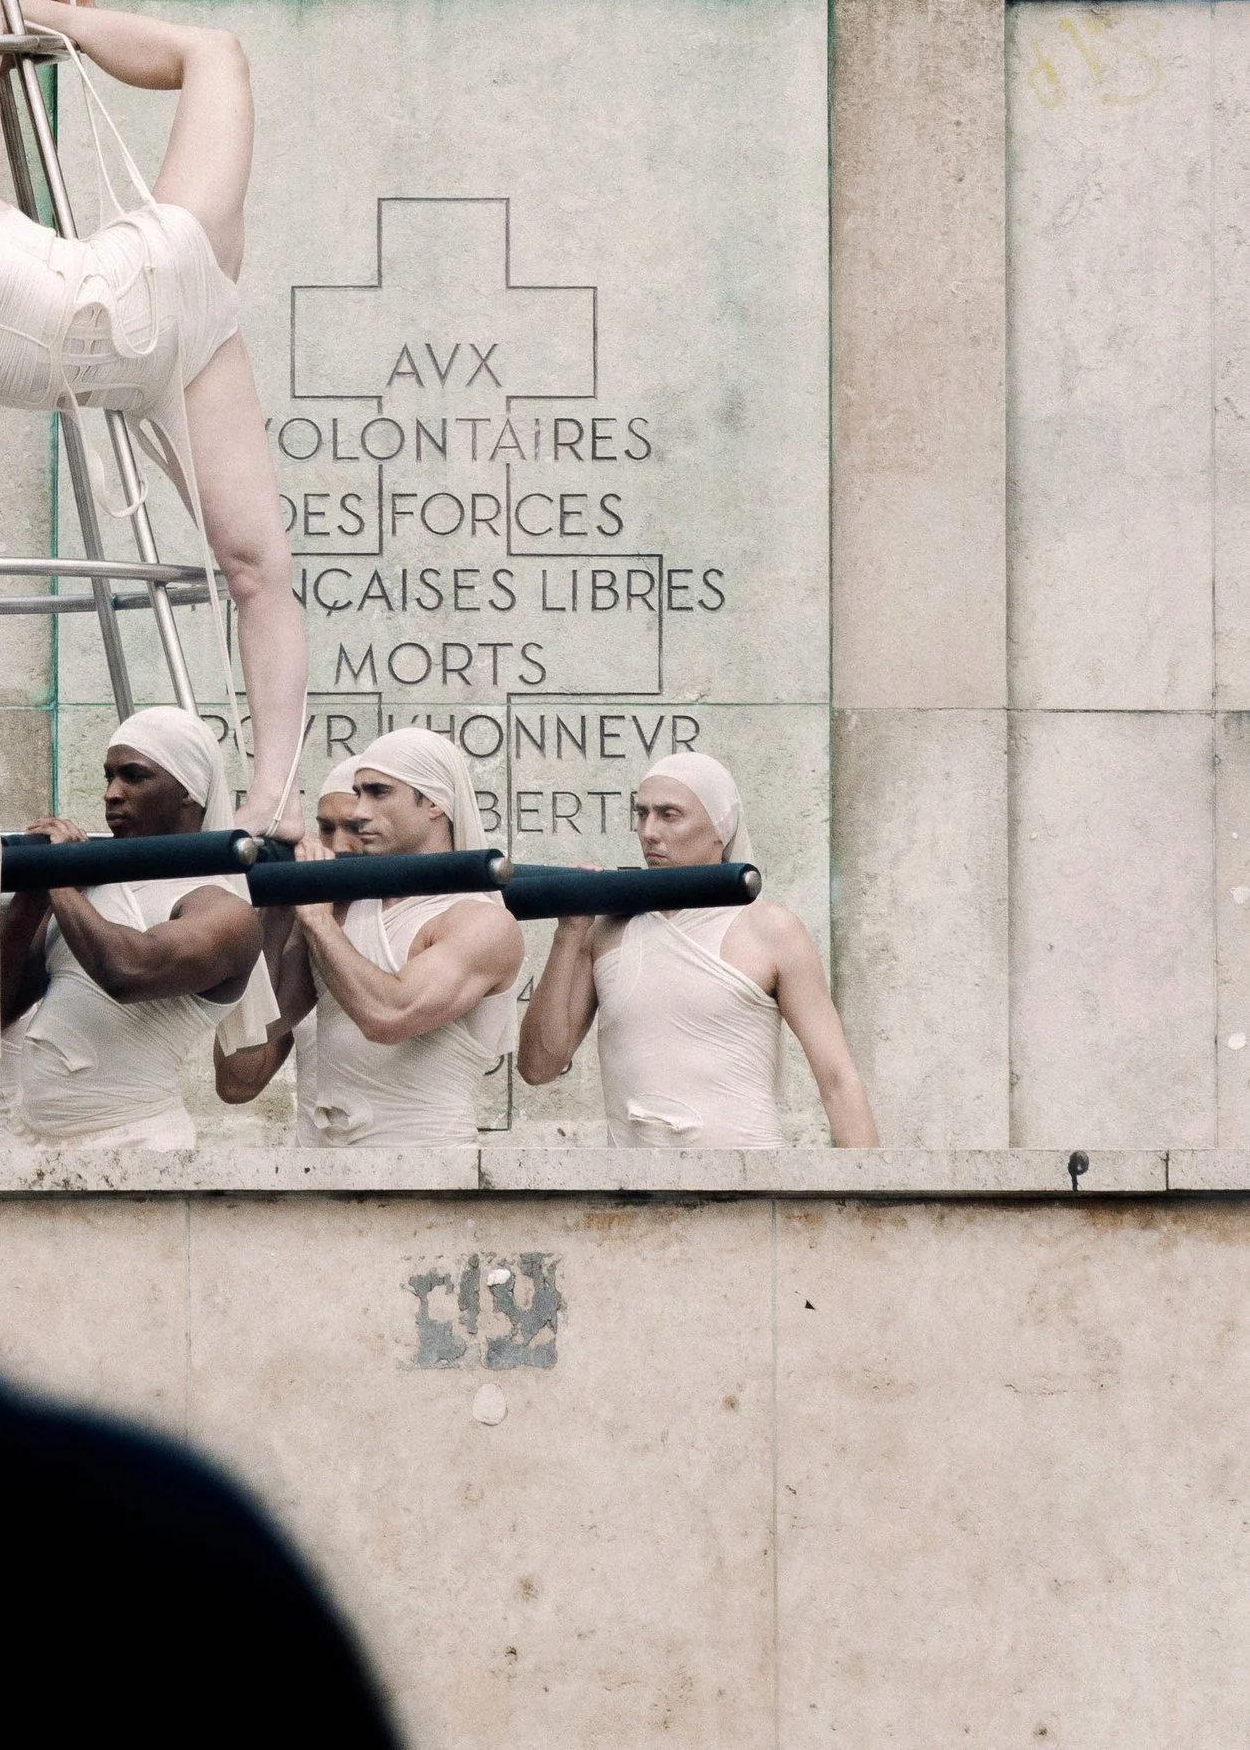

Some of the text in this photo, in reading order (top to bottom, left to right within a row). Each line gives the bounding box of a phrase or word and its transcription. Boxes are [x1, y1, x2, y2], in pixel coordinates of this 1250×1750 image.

[265, 416, 652, 462] OLONTAIRES
[391, 491, 624, 538] FORCES
[541, 567, 726, 612] LIBRES
[334, 641, 548, 687] MORTS
